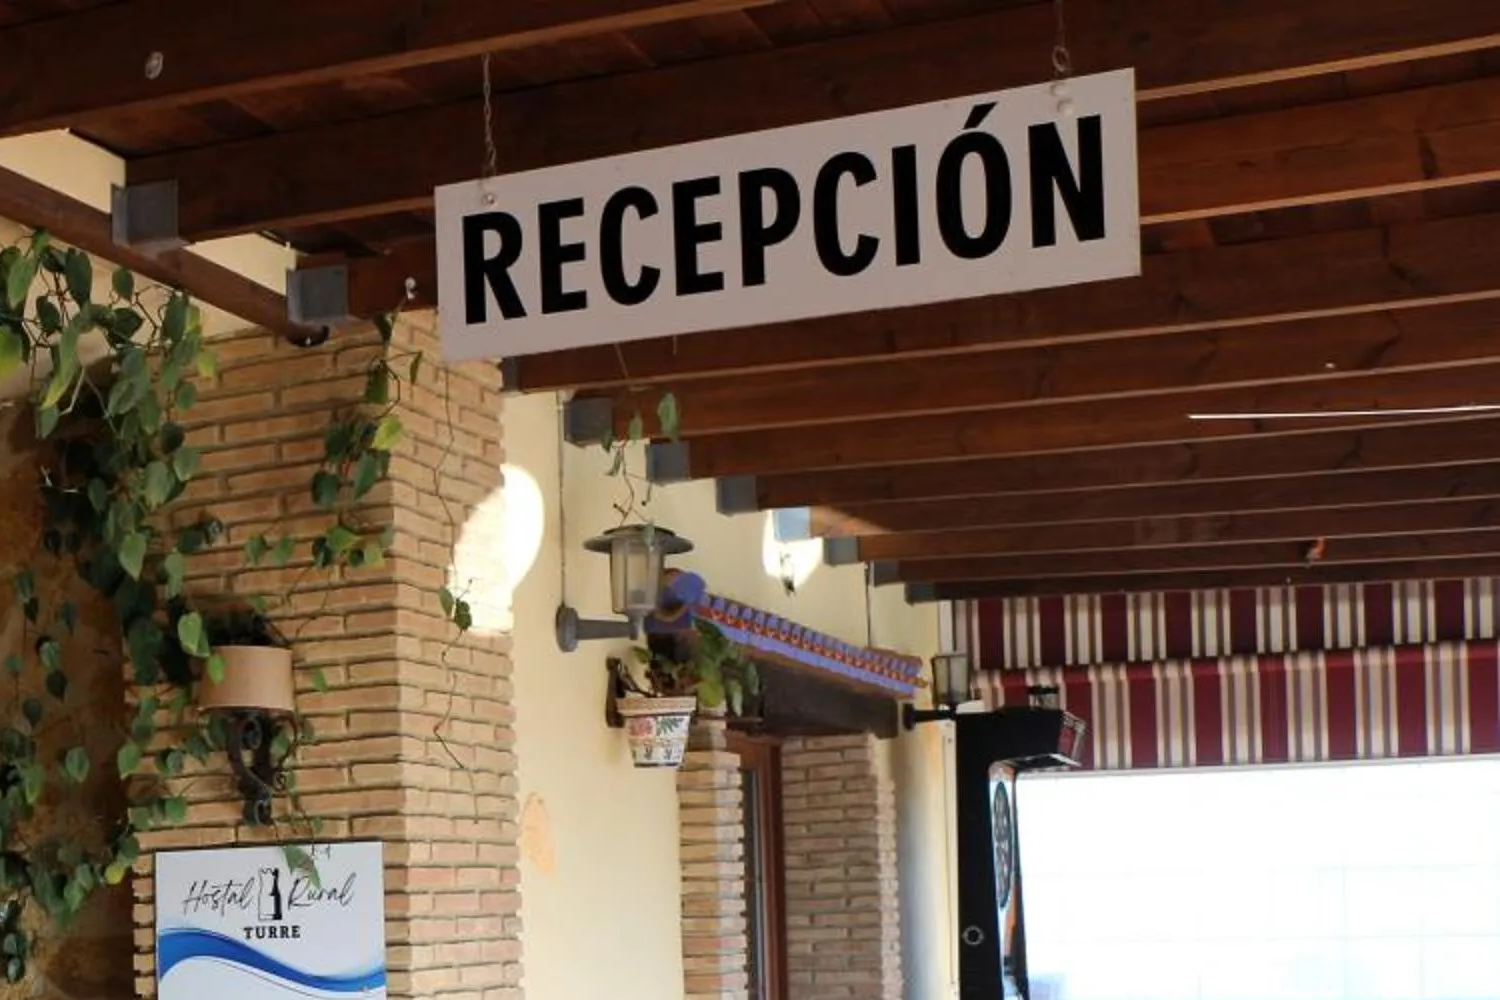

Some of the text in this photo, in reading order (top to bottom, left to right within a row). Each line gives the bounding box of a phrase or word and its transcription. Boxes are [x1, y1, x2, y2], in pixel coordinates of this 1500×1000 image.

[461, 101, 1106, 326] RECEPCIÓN
[181, 872, 358, 917] Hostal Rural
[243, 924, 301, 940] TURRE
